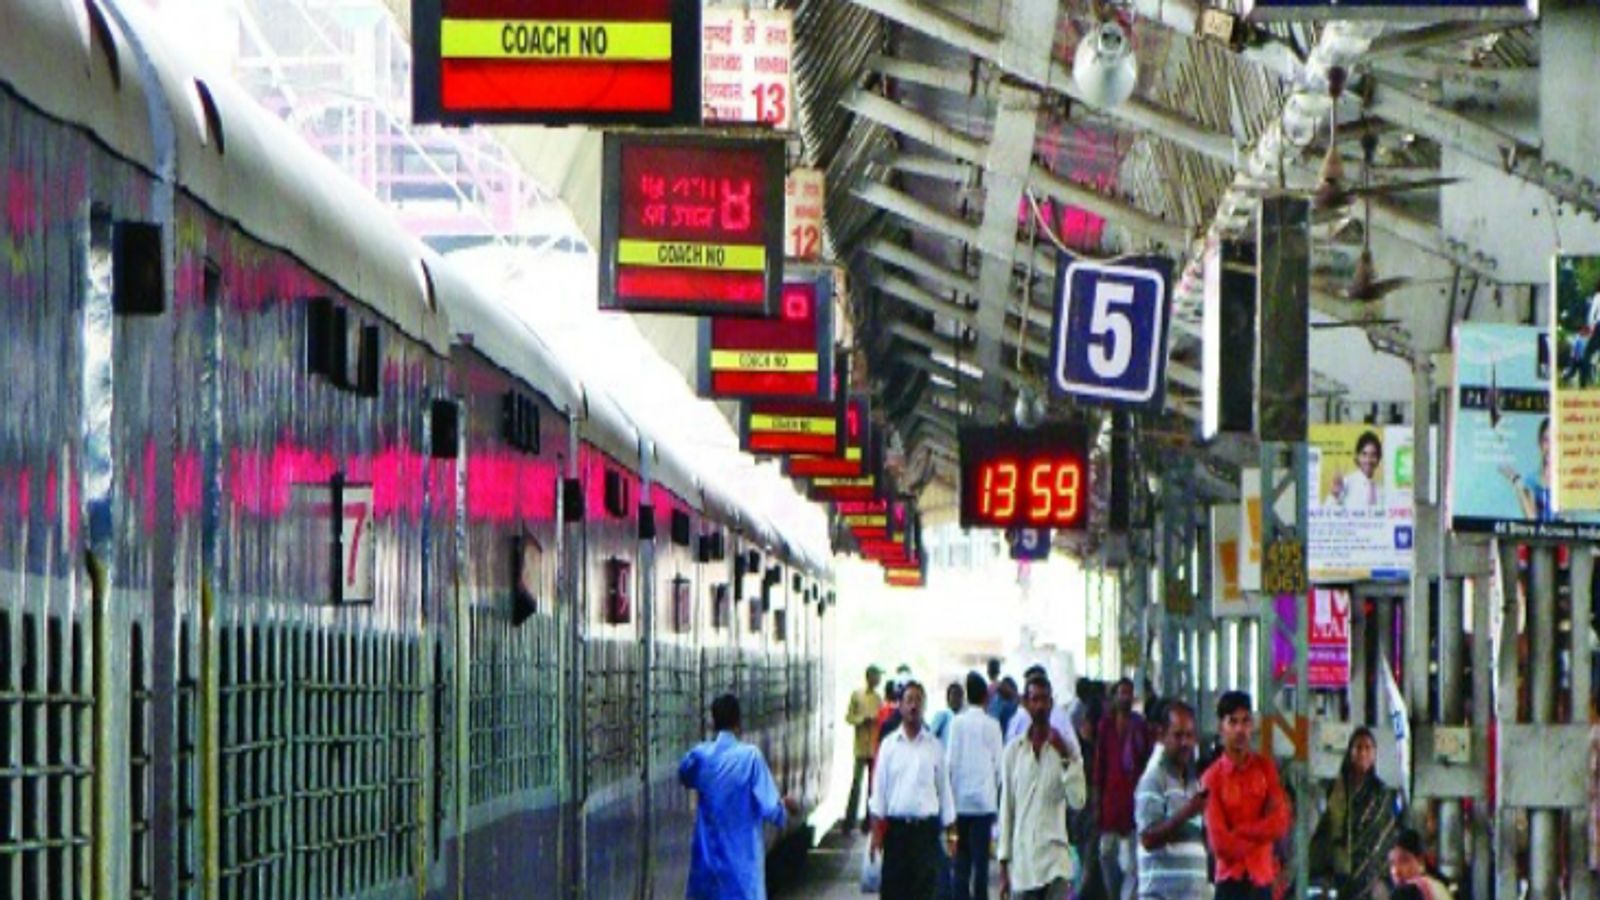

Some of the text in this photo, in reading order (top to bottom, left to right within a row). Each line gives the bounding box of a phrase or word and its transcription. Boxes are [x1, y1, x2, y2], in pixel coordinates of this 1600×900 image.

[501, 23, 608, 55] COACH NO
[751, 83, 785, 125] 13
[657, 245, 724, 266] COACH NO
[792, 224, 818, 261] 12
[1087, 282, 1134, 378] 5
[739, 354, 770, 367] COACH
[343, 502, 367, 587] 7
